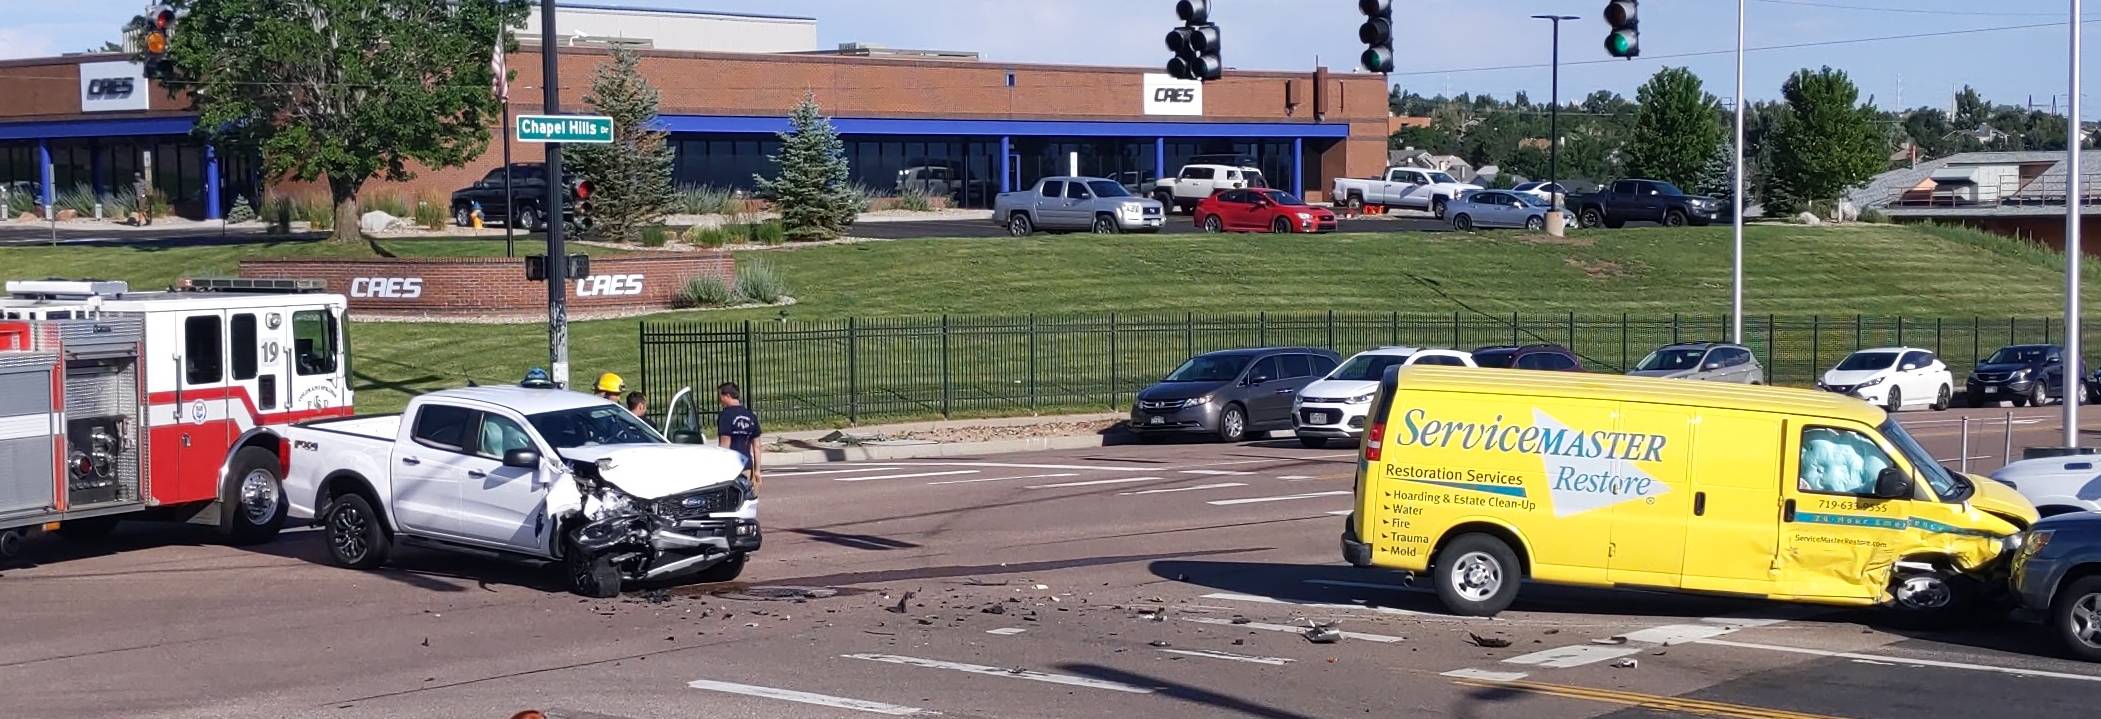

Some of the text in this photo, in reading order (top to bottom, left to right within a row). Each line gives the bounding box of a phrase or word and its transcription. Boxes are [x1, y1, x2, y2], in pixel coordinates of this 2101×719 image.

[87, 77, 134, 99] CAES
[1154, 88, 1195, 103] CAES
[522, 119, 609, 137] Chapel Hills Dr
[350, 277, 423, 298] CAES
[577, 274, 644, 297] CAES
[261, 341, 279, 363] 19
[1386, 463, 1523, 486] Restoration Services
[1553, 465, 1651, 497] Restore
[1393, 504, 1423, 515] Water
[1394, 490, 1535, 511] Hoarding & Estate Clean-Up
[1392, 518, 1410, 528] Fire
[1391, 532, 1429, 544] Trauma
[1391, 546, 1416, 556] Mold
